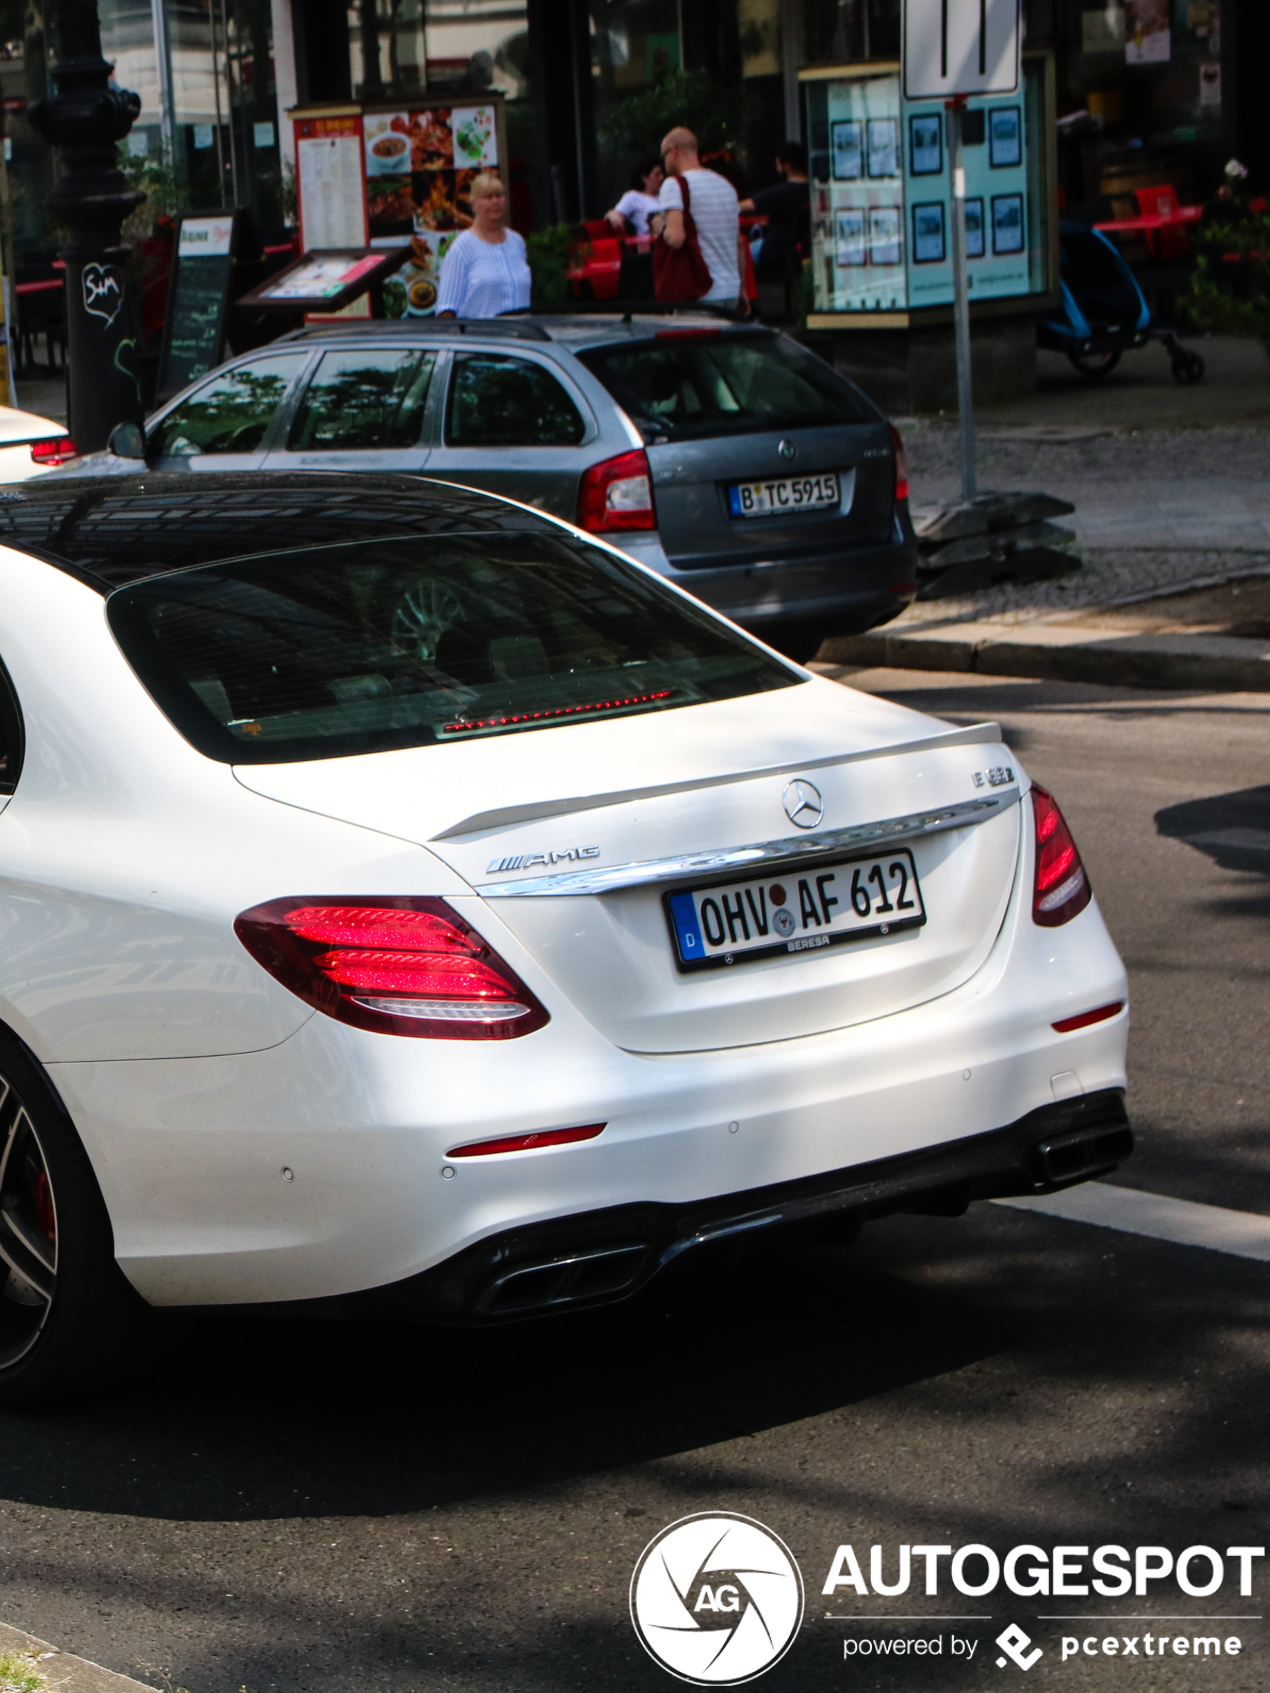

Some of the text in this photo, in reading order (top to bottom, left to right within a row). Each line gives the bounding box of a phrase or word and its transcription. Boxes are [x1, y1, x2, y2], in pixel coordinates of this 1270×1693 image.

[741, 487, 754, 510] B
[765, 483, 790, 506] TC
[792, 477, 836, 503] 5915
[523, 844, 601, 869] AMG
[700, 861, 915, 947] OHV AF 612
[685, 933, 696, 948] D
[787, 935, 831, 952] BERESA
